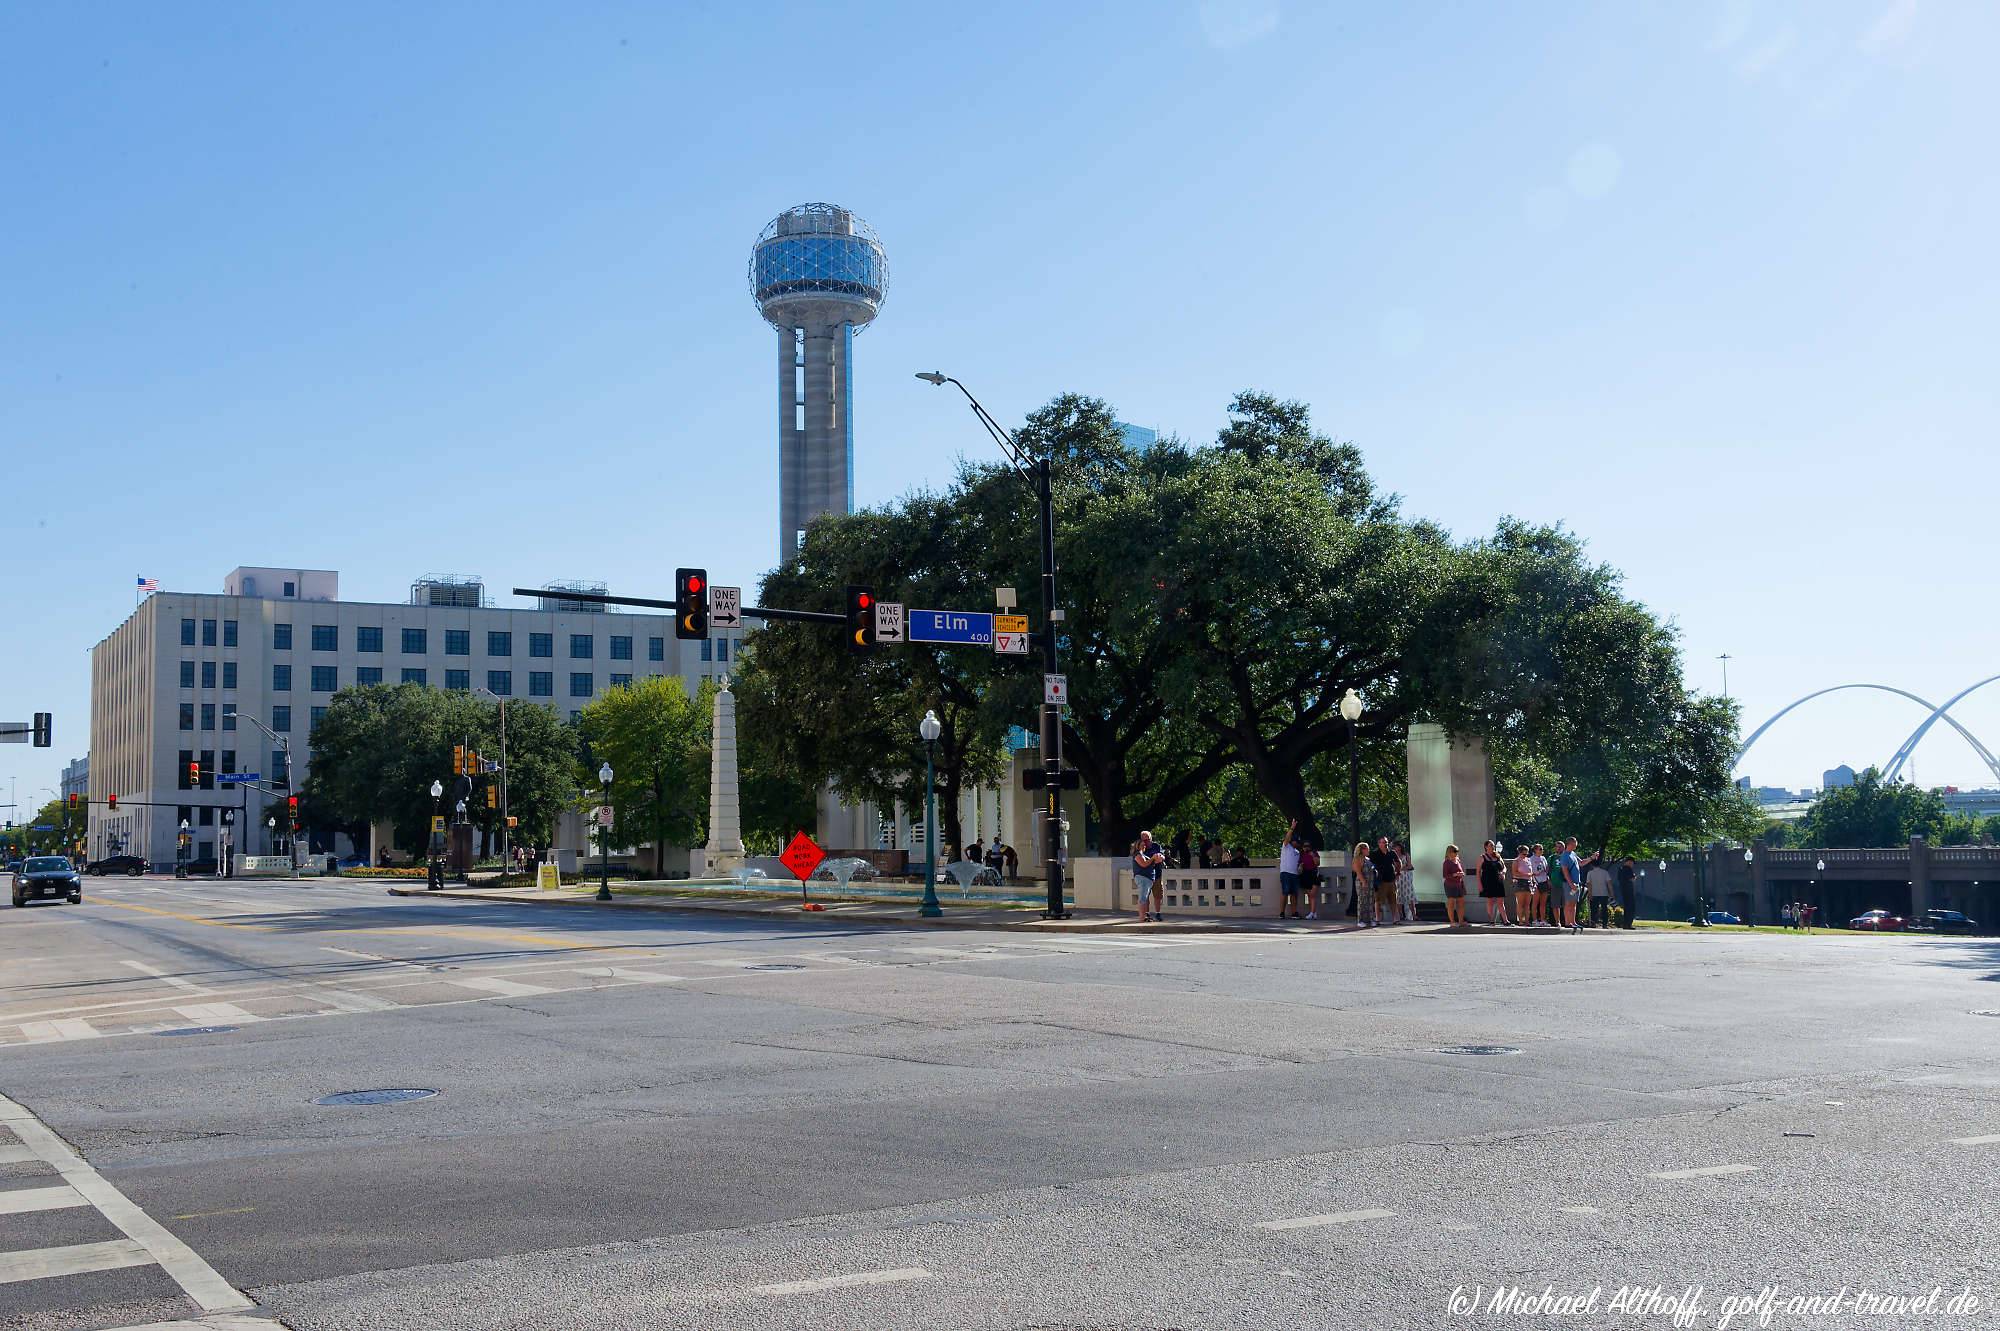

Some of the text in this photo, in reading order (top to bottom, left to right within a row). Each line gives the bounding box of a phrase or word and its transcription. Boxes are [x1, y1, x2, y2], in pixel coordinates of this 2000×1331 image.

[714, 590, 736, 600] ONE
[715, 601, 737, 611] WAY
[879, 605, 899, 615] ONE
[880, 616, 900, 625] WAY
[934, 614, 968, 630] Elm
[970, 633, 989, 642] 400
[793, 861, 815, 869] AHEAD
